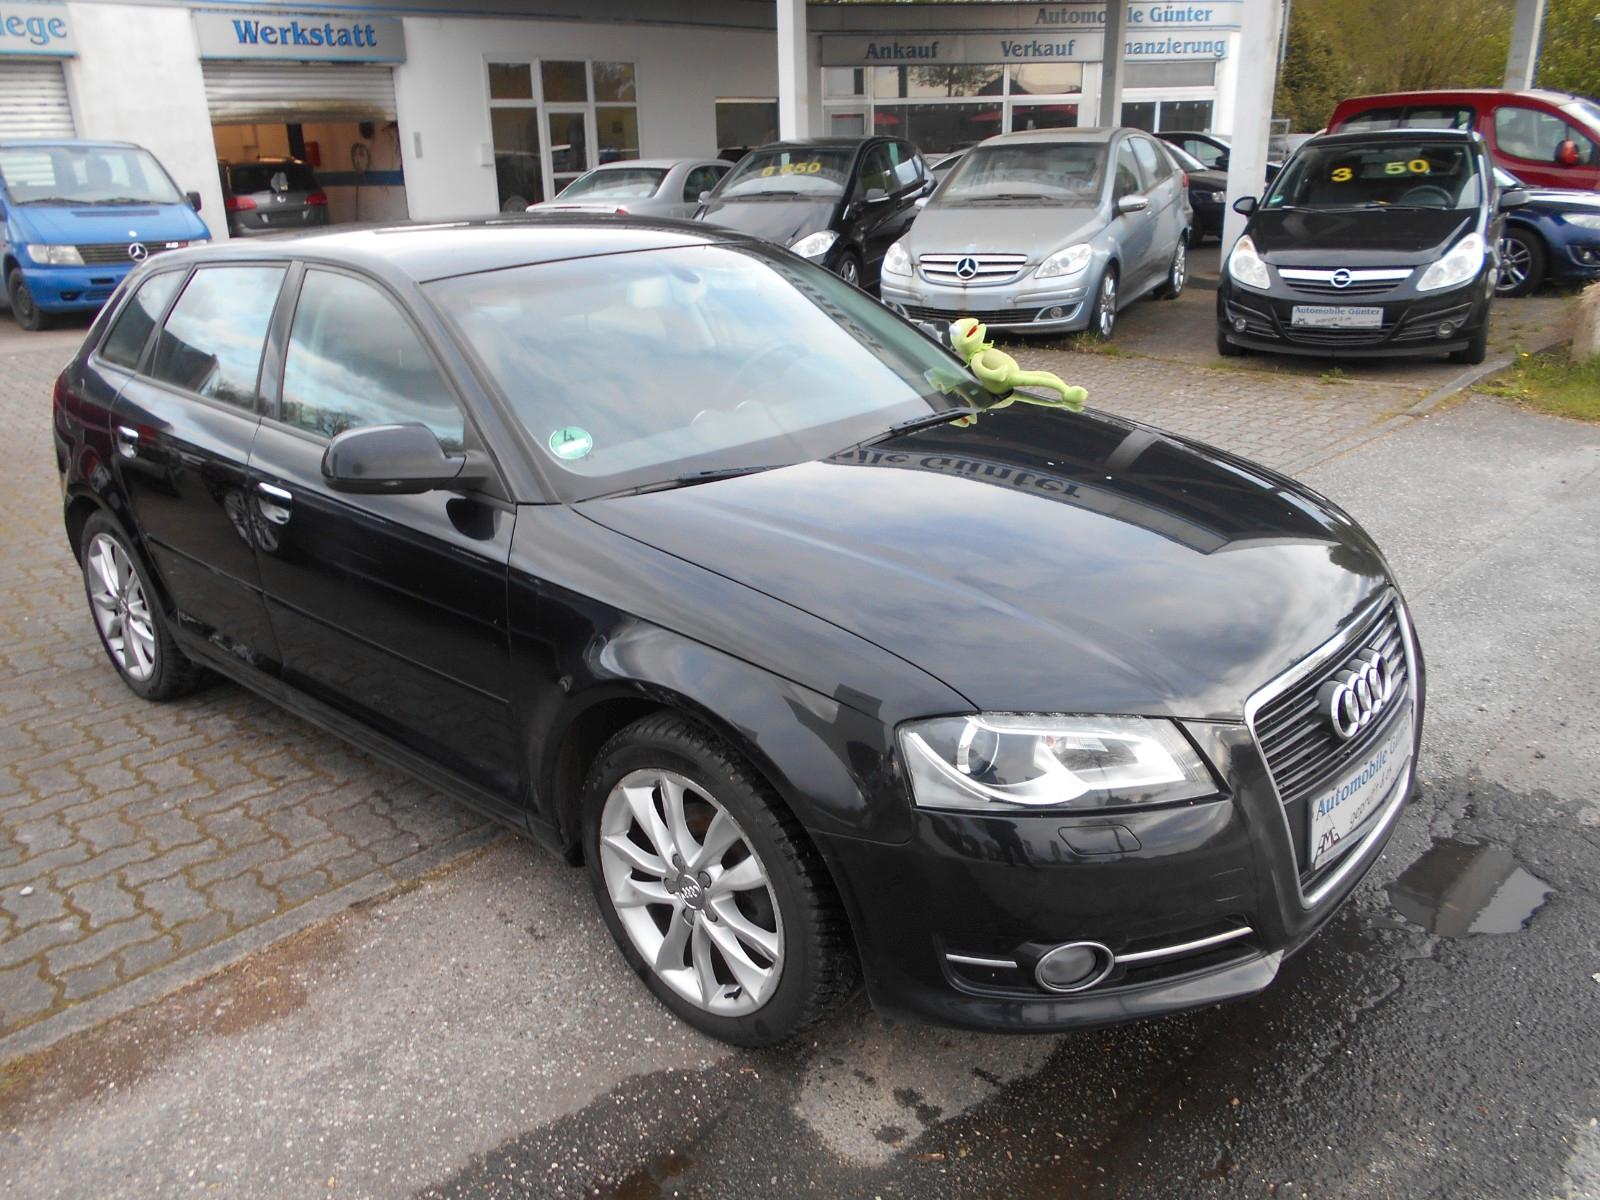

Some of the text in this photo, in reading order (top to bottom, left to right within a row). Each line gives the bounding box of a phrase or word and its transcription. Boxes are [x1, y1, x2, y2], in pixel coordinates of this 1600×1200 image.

[1035, 5, 1213, 25] Automole Günter
[232, 19, 377, 47] Werkstatt
[864, 41, 939, 60] Ankauf
[1000, 39, 1076, 57] Verkauf
[1124, 37, 1226, 58] nanzierung
[1331, 167, 1353, 182] 3
[1316, 750, 1388, 821] Automobile
